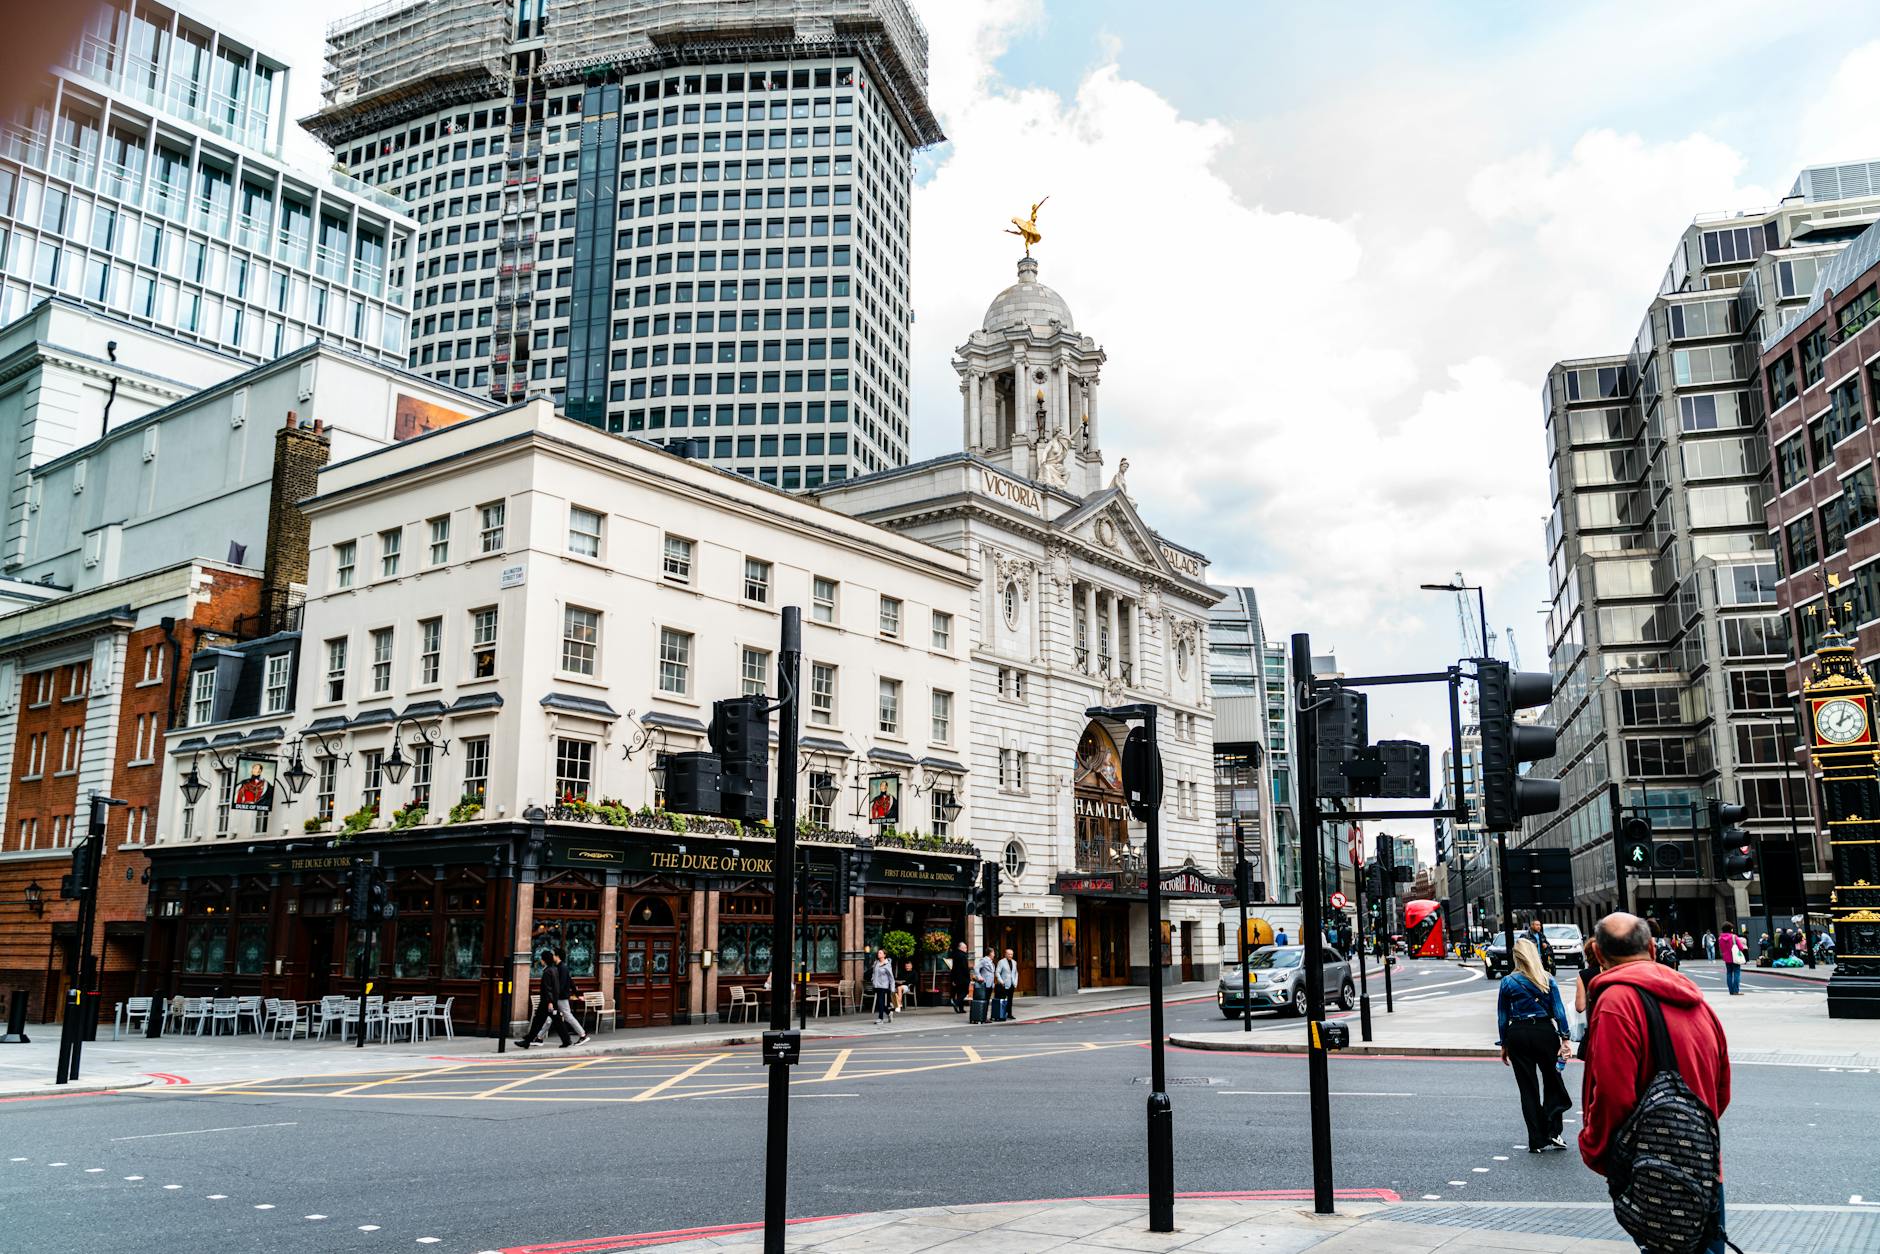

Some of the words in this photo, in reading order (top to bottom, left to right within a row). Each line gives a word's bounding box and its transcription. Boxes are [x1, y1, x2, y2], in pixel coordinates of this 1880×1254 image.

[984, 471, 1040, 511] VICTORIA
[1163, 548, 1199, 577] PALACE
[1075, 798, 1138, 822] HAMILT
[292, 859, 303, 869] THE
[305, 858, 322, 868] DUKE
[323, 858, 333, 867] OF
[333, 857, 351, 867] YORK
[651, 852, 679, 868] THE
[681, 854, 719, 870] DUKE
[720, 856, 738, 871] OF
[740, 858, 773, 873] YORK
[884, 868, 900, 877] FIRST
[900, 870, 918, 879] FLOOR
[918, 871, 929, 880] BAR
[935, 872, 955, 881] DINING
[1160, 874, 1187, 891] VICTORIA
[1189, 874, 1217, 894] PALACE
